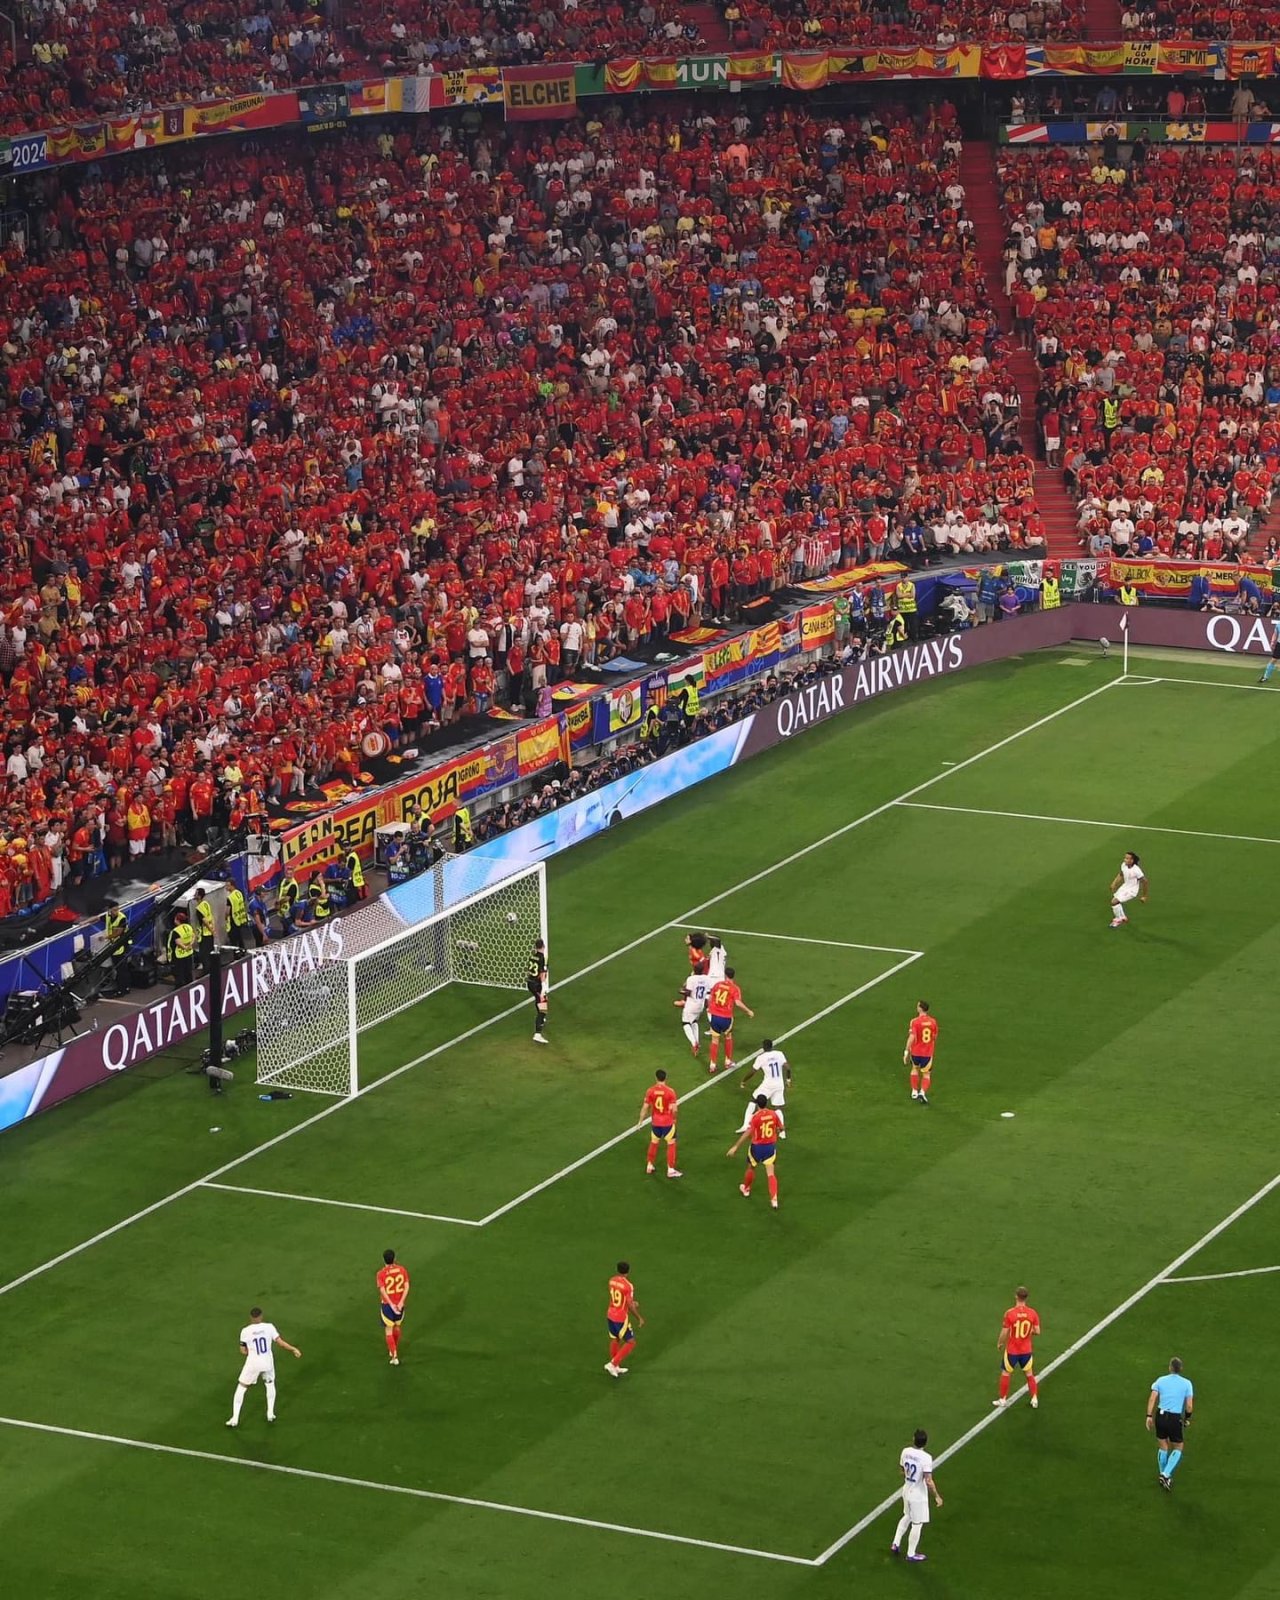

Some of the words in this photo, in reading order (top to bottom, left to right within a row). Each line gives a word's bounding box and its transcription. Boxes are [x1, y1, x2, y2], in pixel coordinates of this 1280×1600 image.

[1131, 43, 1152, 51] LIM
[1125, 57, 1157, 66] HOME
[446, 86, 468, 95] HOME
[509, 81, 570, 107] ELCHE
[13, 141, 47, 168] 2024
[777, 674, 845, 737] QATAR
[853, 634, 963, 701] AIRWAYS
[102, 983, 209, 1072] QATAR
[221, 918, 343, 1015] AIRWAYS
[695, 985, 705, 1000] 13
[714, 988, 729, 1007] 14
[921, 1027, 932, 1044] 8
[768, 1061, 780, 1078] 11
[654, 1095, 664, 1113] 4
[760, 1120, 774, 1139] 16
[385, 1273, 405, 1295] 22
[610, 1287, 623, 1308] 19
[1013, 1319, 1031, 1339] 10
[253, 1336, 268, 1355] 10
[904, 1462, 917, 1482] 22
